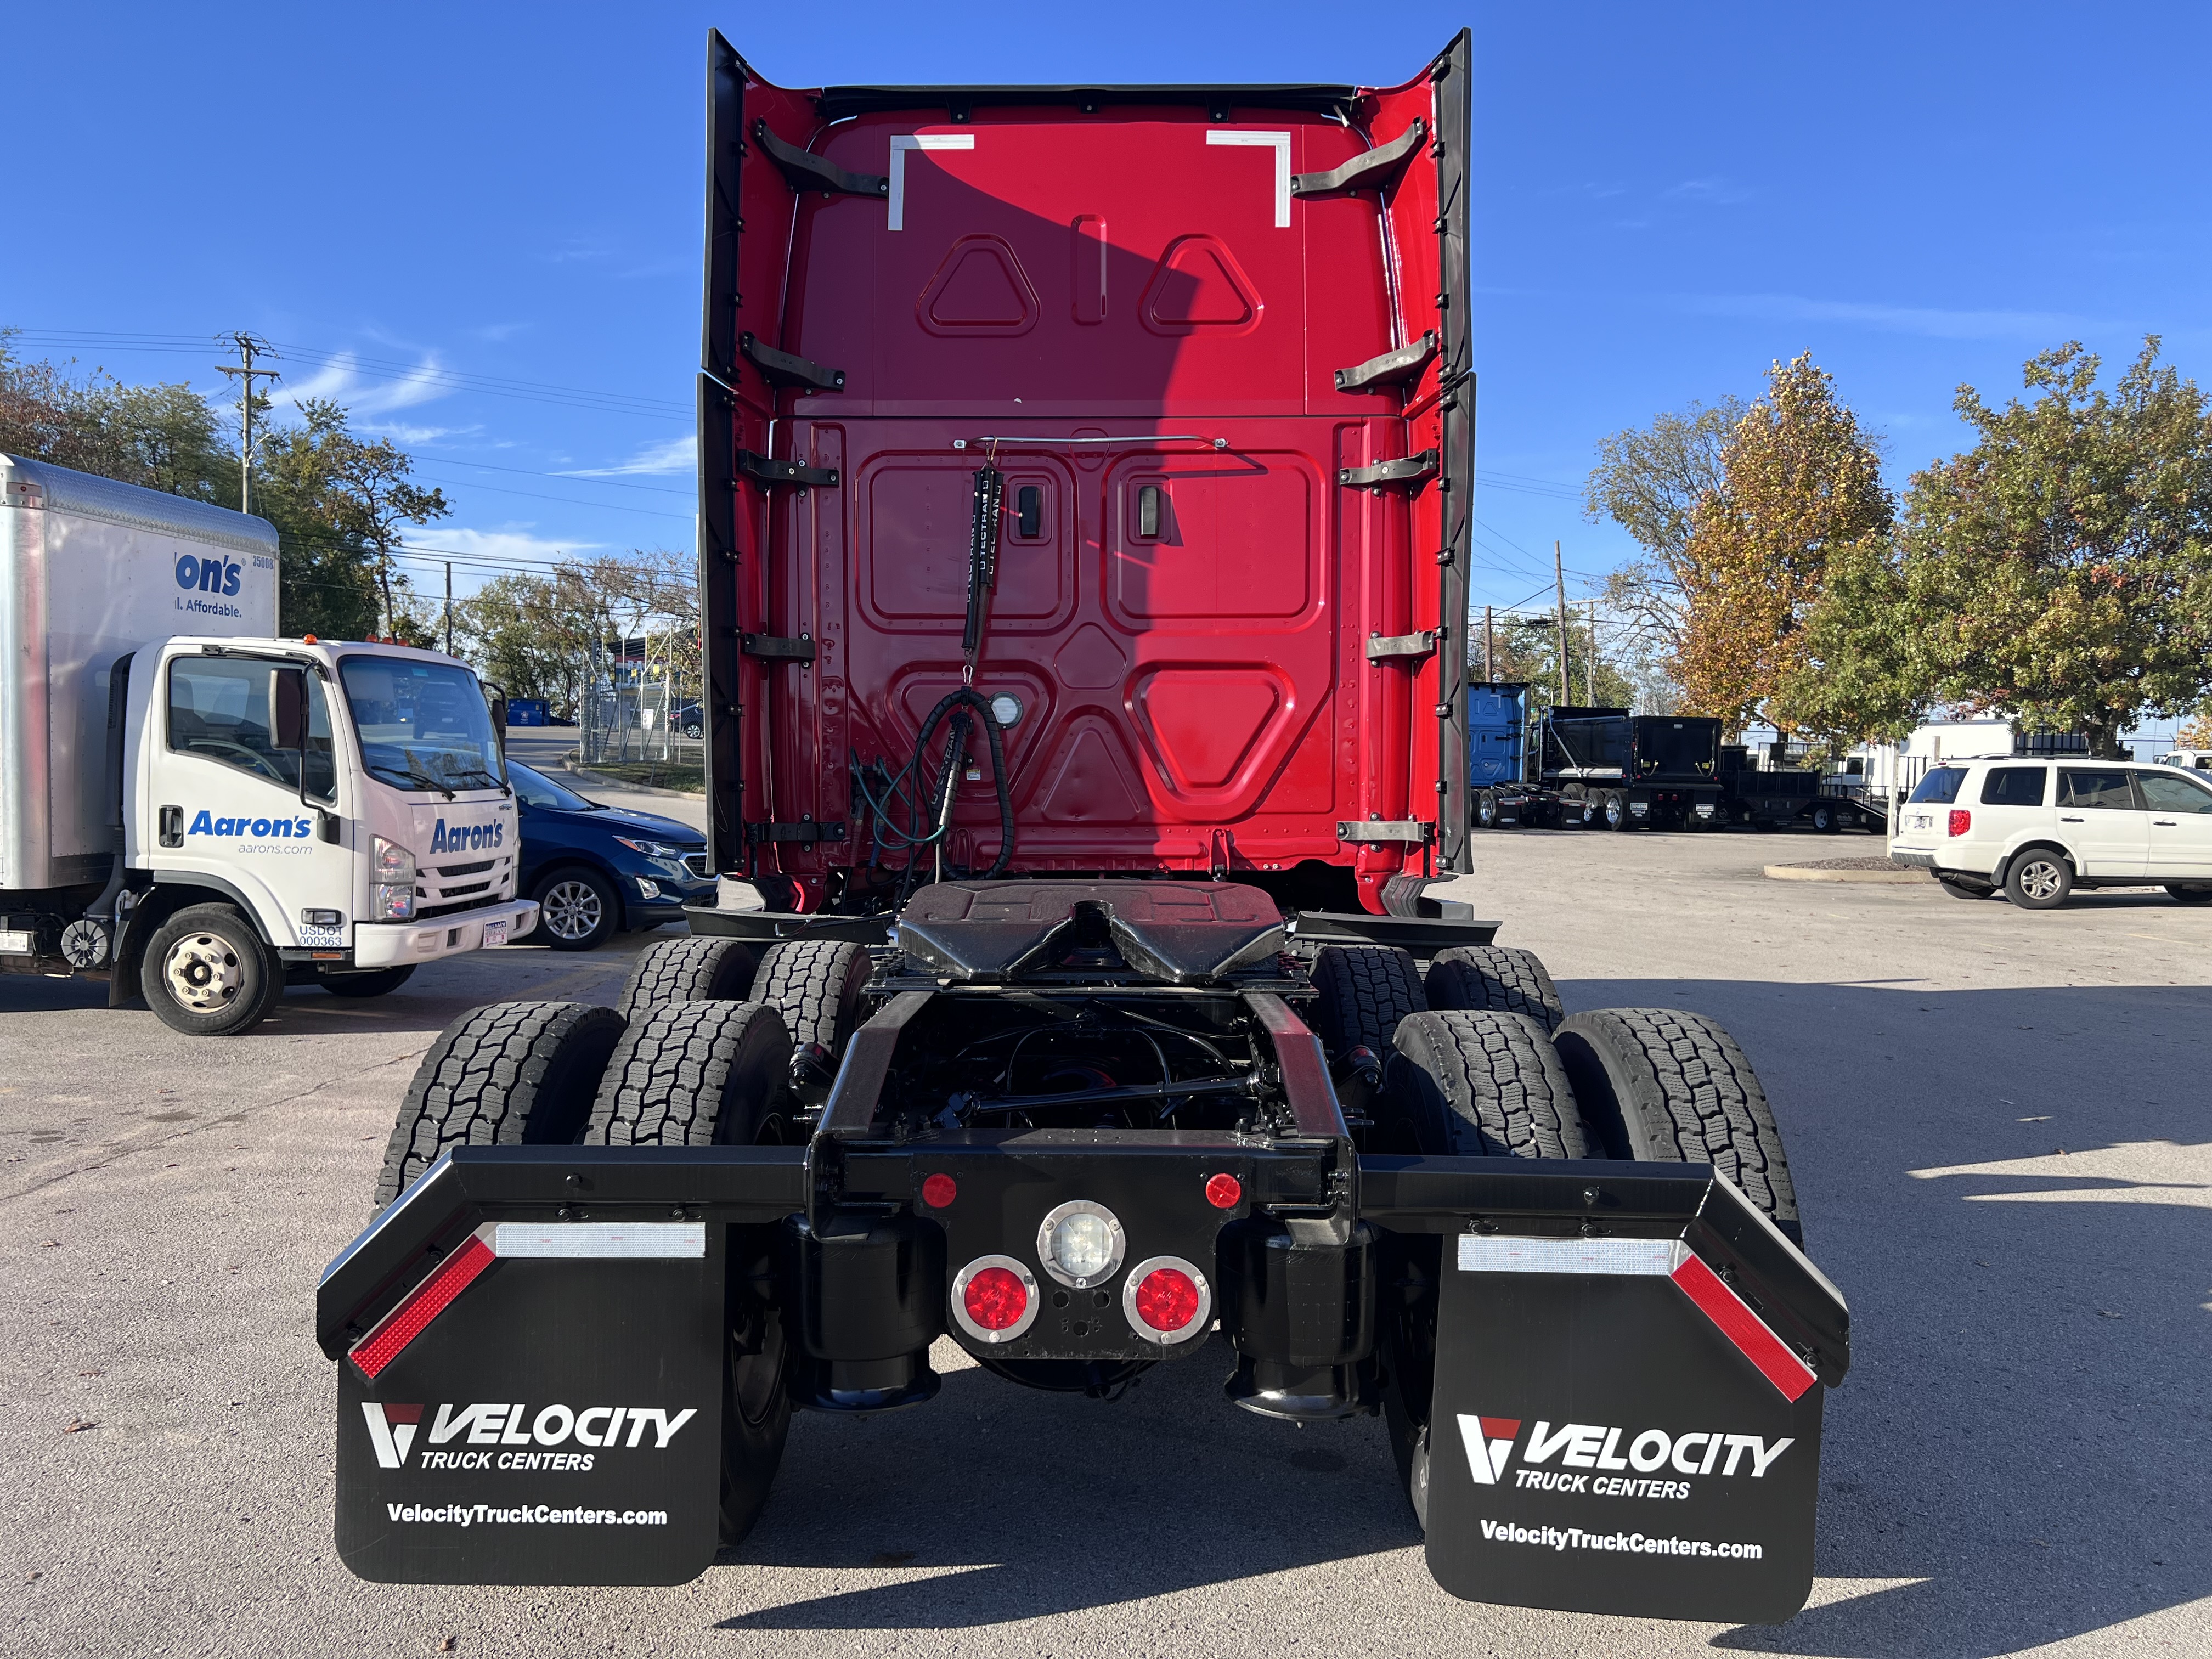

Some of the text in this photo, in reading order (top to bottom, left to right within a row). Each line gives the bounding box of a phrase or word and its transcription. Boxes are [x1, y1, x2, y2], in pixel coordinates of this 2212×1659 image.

[980, 494, 989, 557] TECTRAN
[990, 498, 1000, 560] TECRAN
[174, 552, 242, 596] on's
[253, 555, 273, 570] 35008
[186, 599, 242, 618] Affordable.
[188, 810, 312, 838] Aaron's
[430, 818, 503, 855] Aaron's
[238, 844, 312, 855] aarons.com
[300, 926, 345, 935] USDOT
[300, 936, 342, 946] 000363
[429, 1403, 698, 1448] VELOCITY
[421, 1452, 595, 1471] TRUCK CENTERS
[1523, 1421, 1796, 1477] VELOCITY
[1516, 1469, 1691, 1500] TRUCK CENTERS
[387, 1503, 667, 1527] VelocityTruckCenters.com
[1481, 1520, 1762, 1559] VelocityTruckCenters.com
